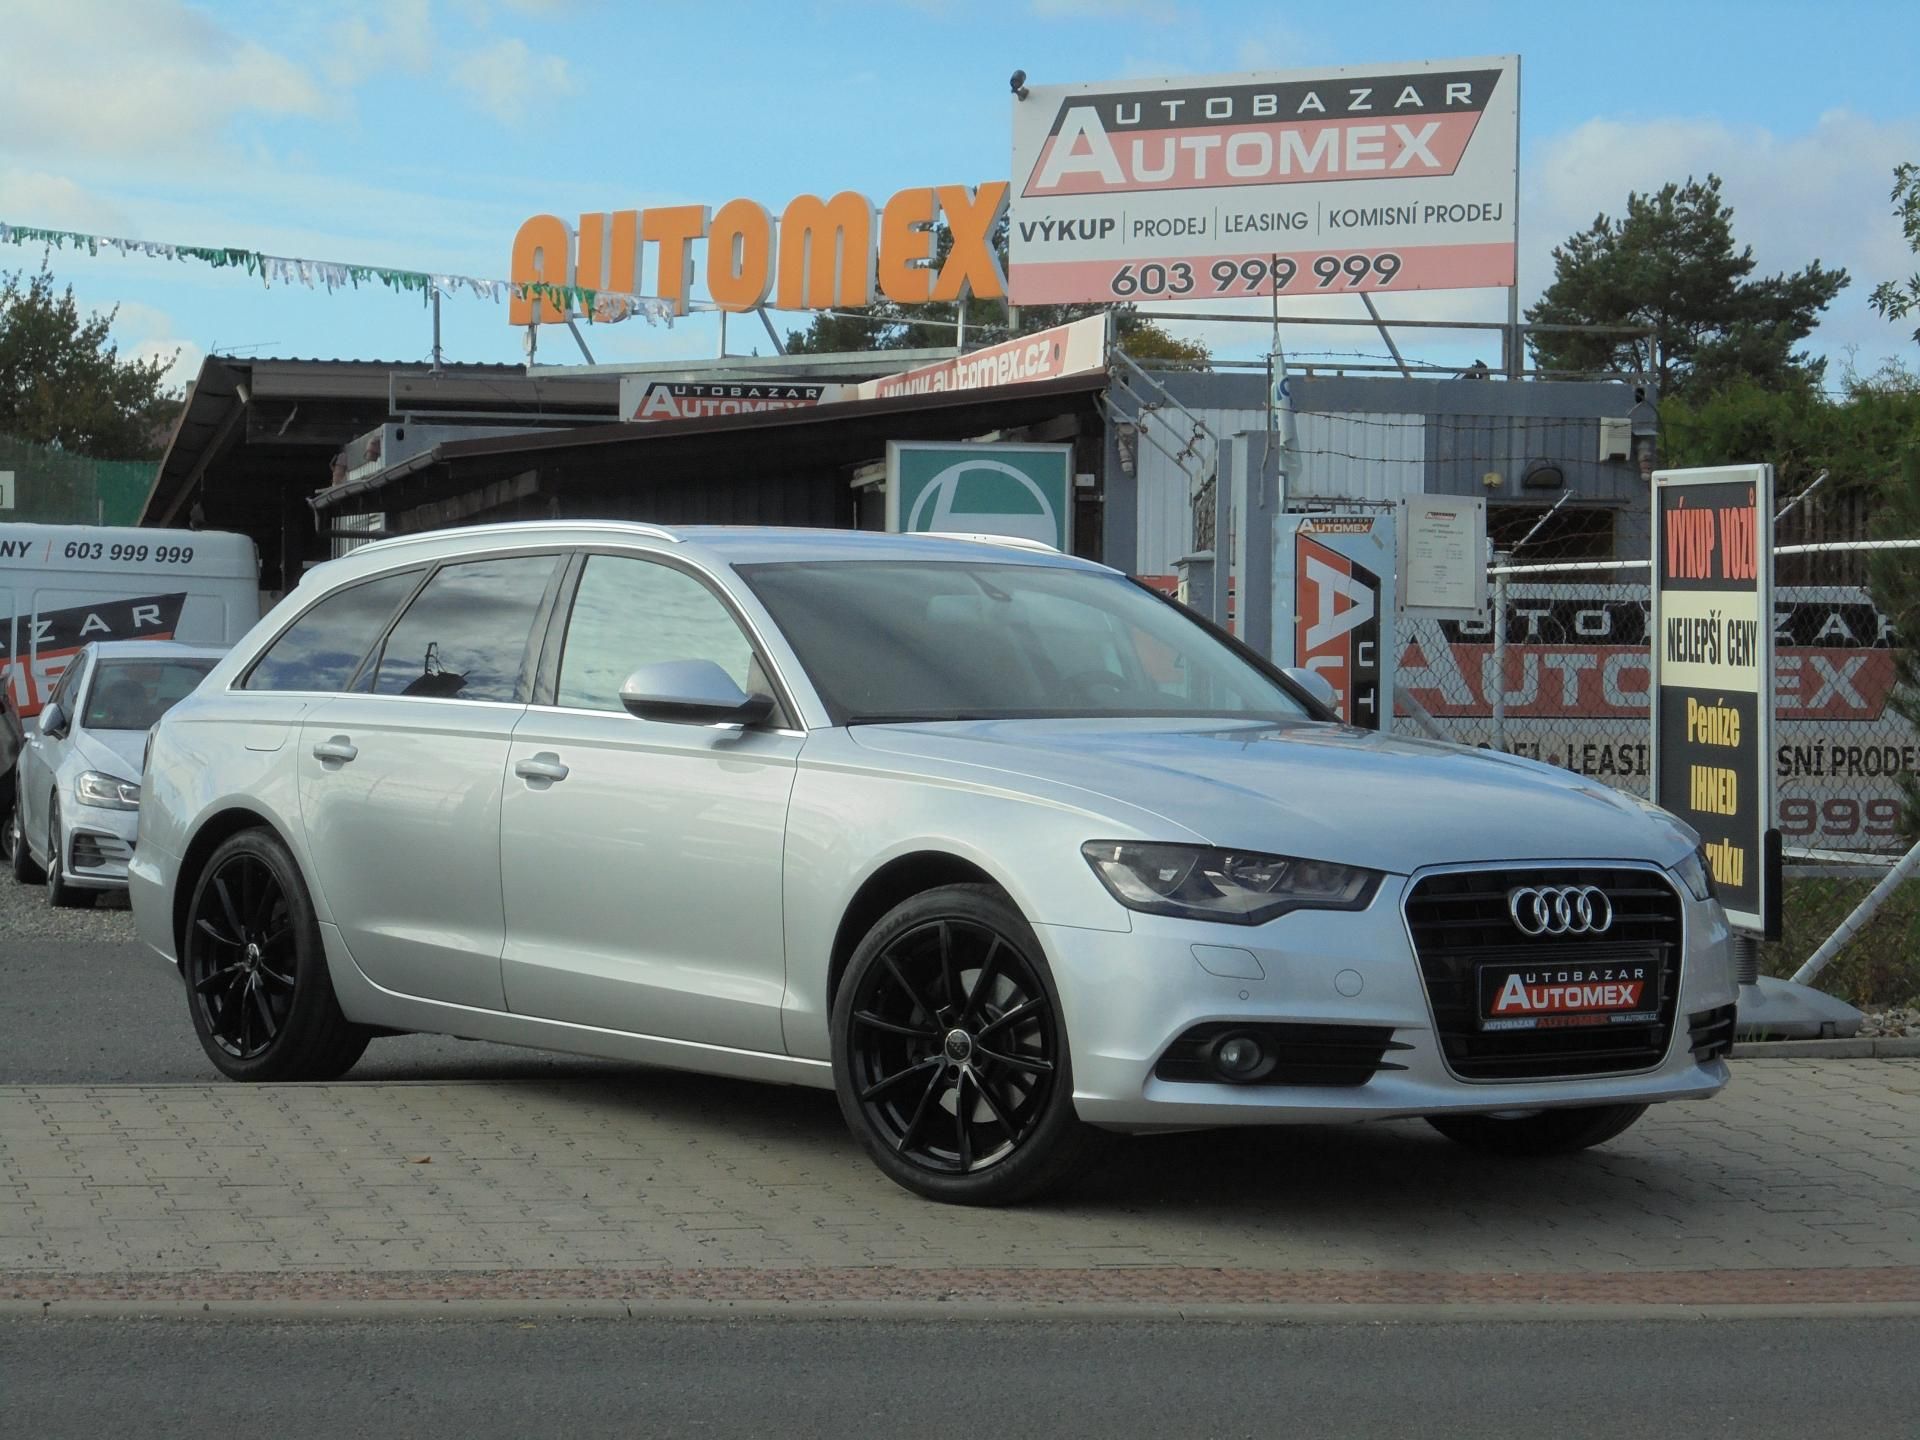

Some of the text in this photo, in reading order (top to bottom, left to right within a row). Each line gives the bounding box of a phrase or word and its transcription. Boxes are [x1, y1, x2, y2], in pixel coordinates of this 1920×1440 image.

[1035, 105, 1442, 188] AUTOMEX
[1019, 201, 1504, 243] VÝKUP PRODEJ LEASING KOMISNÍ PRODEJ
[510, 181, 1010, 326] AUTOMEX
[1111, 253, 1402, 296] 603 999 999
[641, 386, 806, 417] AUTOM
[1299, 518, 1369, 533] AUTOMEX
[1666, 487, 1757, 580] VÝKUP VOZŮ
[64, 541, 104, 560] 603
[109, 544, 148, 562] 999
[155, 546, 194, 564] 999
[1667, 609, 1757, 667] NEJLEPŠÍ CENY
[1687, 697, 1740, 747] Peníze
[1690, 765, 1737, 816] IHNED
[1497, 974, 1634, 1011] AUTOMEX
